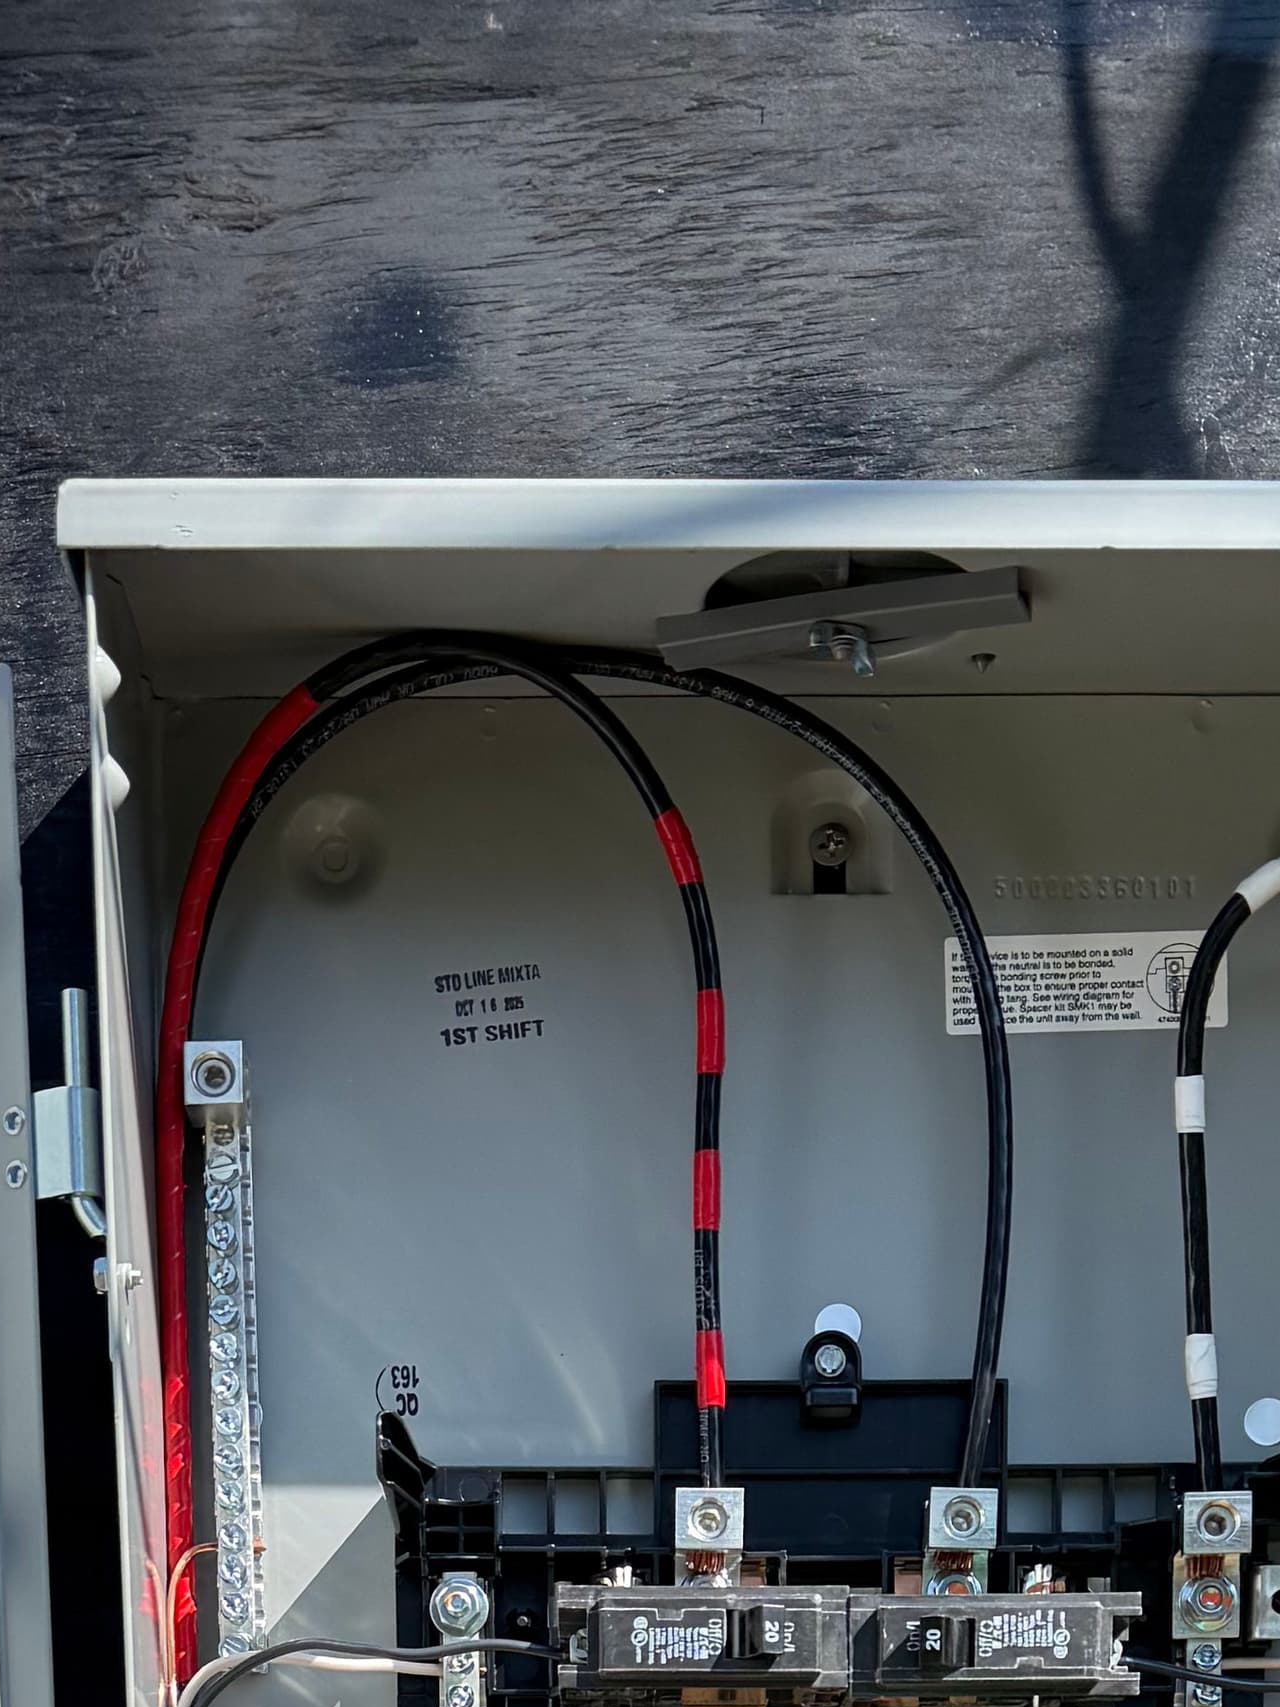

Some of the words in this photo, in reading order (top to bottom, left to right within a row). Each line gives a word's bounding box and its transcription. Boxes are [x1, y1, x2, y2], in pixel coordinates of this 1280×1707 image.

[1011, 952, 1018, 960] is
[1021, 952, 1030, 960] to
[1033, 951, 1044, 959] be
[1047, 949, 1087, 958] mounted
[1112, 948, 1134, 957] solid
[1009, 961, 1040, 970] neutral
[1043, 961, 1050, 969] is
[1053, 961, 1061, 969] to
[1064, 960, 1076, 969] be
[1078, 959, 1115, 969] bonded,
[434, 974, 462, 993] STD
[466, 969, 494, 990] LINE
[498, 964, 541, 984] MIXTA
[1001, 973, 1037, 982] bonding
[1040, 972, 1067, 980] screw
[1069, 971, 1090, 980] prior
[1092, 970, 1101, 978] to
[1014, 982, 1030, 991] box
[1033, 982, 1042, 991] to
[1044, 982, 1076, 991] ensure
[1079, 981, 1108, 991] proper
[1110, 979, 1144, 988] contact
[1032, 993, 1050, 1001] See
[1053, 992, 1080, 1003] wiring
[1083, 990, 1120, 1001] diagram
[1122, 990, 1134, 999] for
[1020, 1003, 1052, 1014] Spacer
[1055, 1003, 1065, 1012] kit
[1068, 1002, 1095, 1011] SMK1
[1098, 1002, 1117, 1011] may
[1120, 1000, 1131, 1009] be
[953, 1017, 975, 1025] used
[1019, 1015, 1034, 1023] the
[1036, 1014, 1052, 1023] unit
[1055, 1014, 1079, 1024] away
[1082, 1013, 1103, 1021] from
[1105, 1013, 1119, 1021] the
[1122, 1011, 1141, 1021] wall.
[440, 1026, 478, 1047] 1ST
[485, 1019, 545, 1042] SHIFT
[391, 1365, 420, 1390] 163
[395, 1393, 419, 1417] QC
[765, 1621, 780, 1643] 20
[926, 1629, 941, 1650] 20
